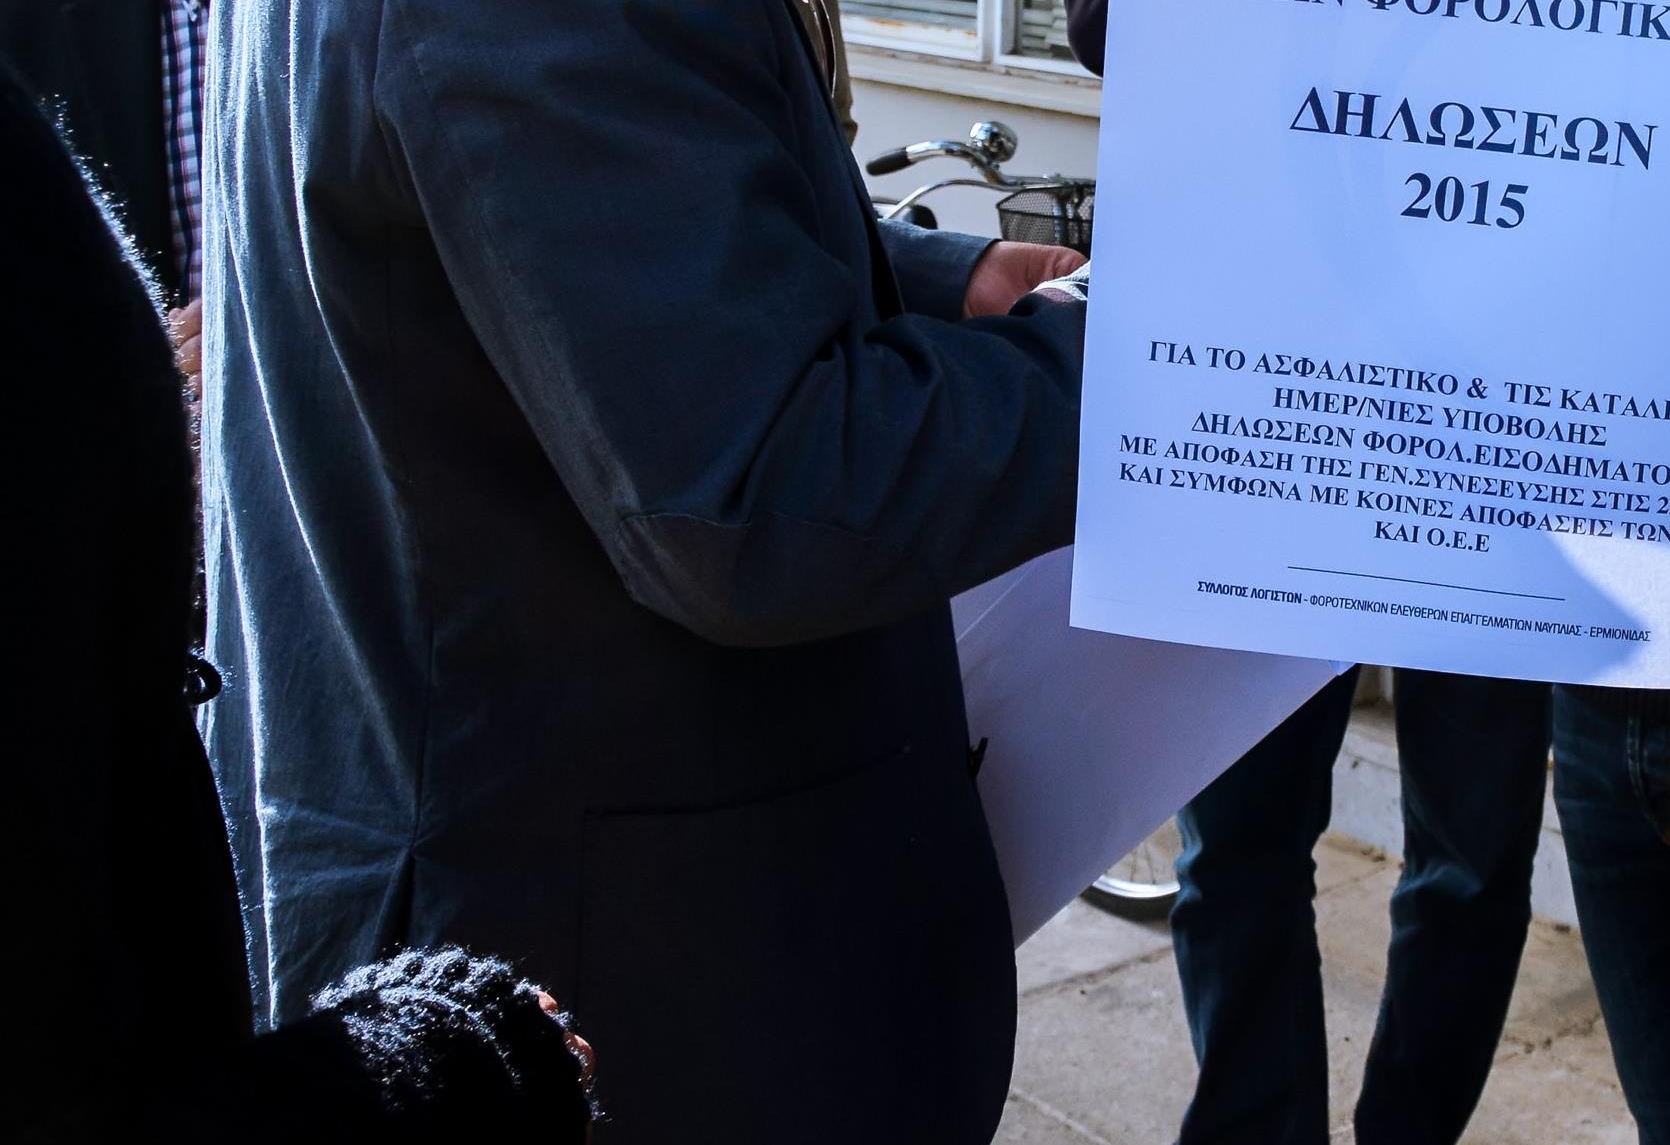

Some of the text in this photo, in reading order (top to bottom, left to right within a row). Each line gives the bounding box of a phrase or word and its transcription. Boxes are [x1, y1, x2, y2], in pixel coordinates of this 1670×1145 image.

[1289, 86, 1659, 171] ΔΗΛΩΣΕΩΝ
[1400, 171, 1530, 229] 2015
[1148, 340, 1197, 367] ΓΙΑ
[1206, 346, 1247, 371] ΤΟ
[1252, 352, 1459, 396] ΑΣΦΑΛΙΣΤΙΚΟ
[1466, 376, 1489, 400] &
[1504, 381, 1552, 408] ΤΙΣ
[1191, 411, 1356, 450] ΔΗΛΩΣΕΩΝ
[1272, 387, 1608, 448] ΗΜΕΡ/ΝΙΕΣ ΥΠΟΒΟΛΗΣ
[1119, 434, 1157, 457] ΜΕ
[1164, 440, 1294, 473] ΑΠΟΦΑΣΗ
[1301, 454, 1353, 479] ΤΗΣ
[1592, 490, 1651, 515] ΣΤΙΣ
[1119, 462, 1164, 487] ΚΑΙ
[1168, 469, 1303, 503] ΣΥΜΦΩΝΑ
[1310, 484, 1350, 507] ΜΕ
[1355, 489, 1454, 521] ΚΟΙΝΕΣ
[1459, 503, 1614, 539] ΑΠΟΦΑΣΕΙΣ
[1373, 520, 1490, 554] ΚΑΙ Ο.Ε.Ε
[1197, 580, 1249, 598] ΣΥΛΛΟΓΟΣ
[1250, 587, 1303, 605] ΛΟΓΙΣΤΩΝ
[1309, 594, 1389, 615] ΦΟΡΟΤΕΧΝΙΚΩΝ
[1390, 603, 1449, 622] ΕΛΕΥΘΕΡΩΝ
[1450, 611, 1533, 633] ΕΠΑΓΓΕΛΜΑΤΙΩΝ
[1534, 621, 1583, 638] ΝΑΥΠΛΙΑΣ
[1589, 626, 1652, 643] ΕΡΜΙΟΝΙΔΑΣ
